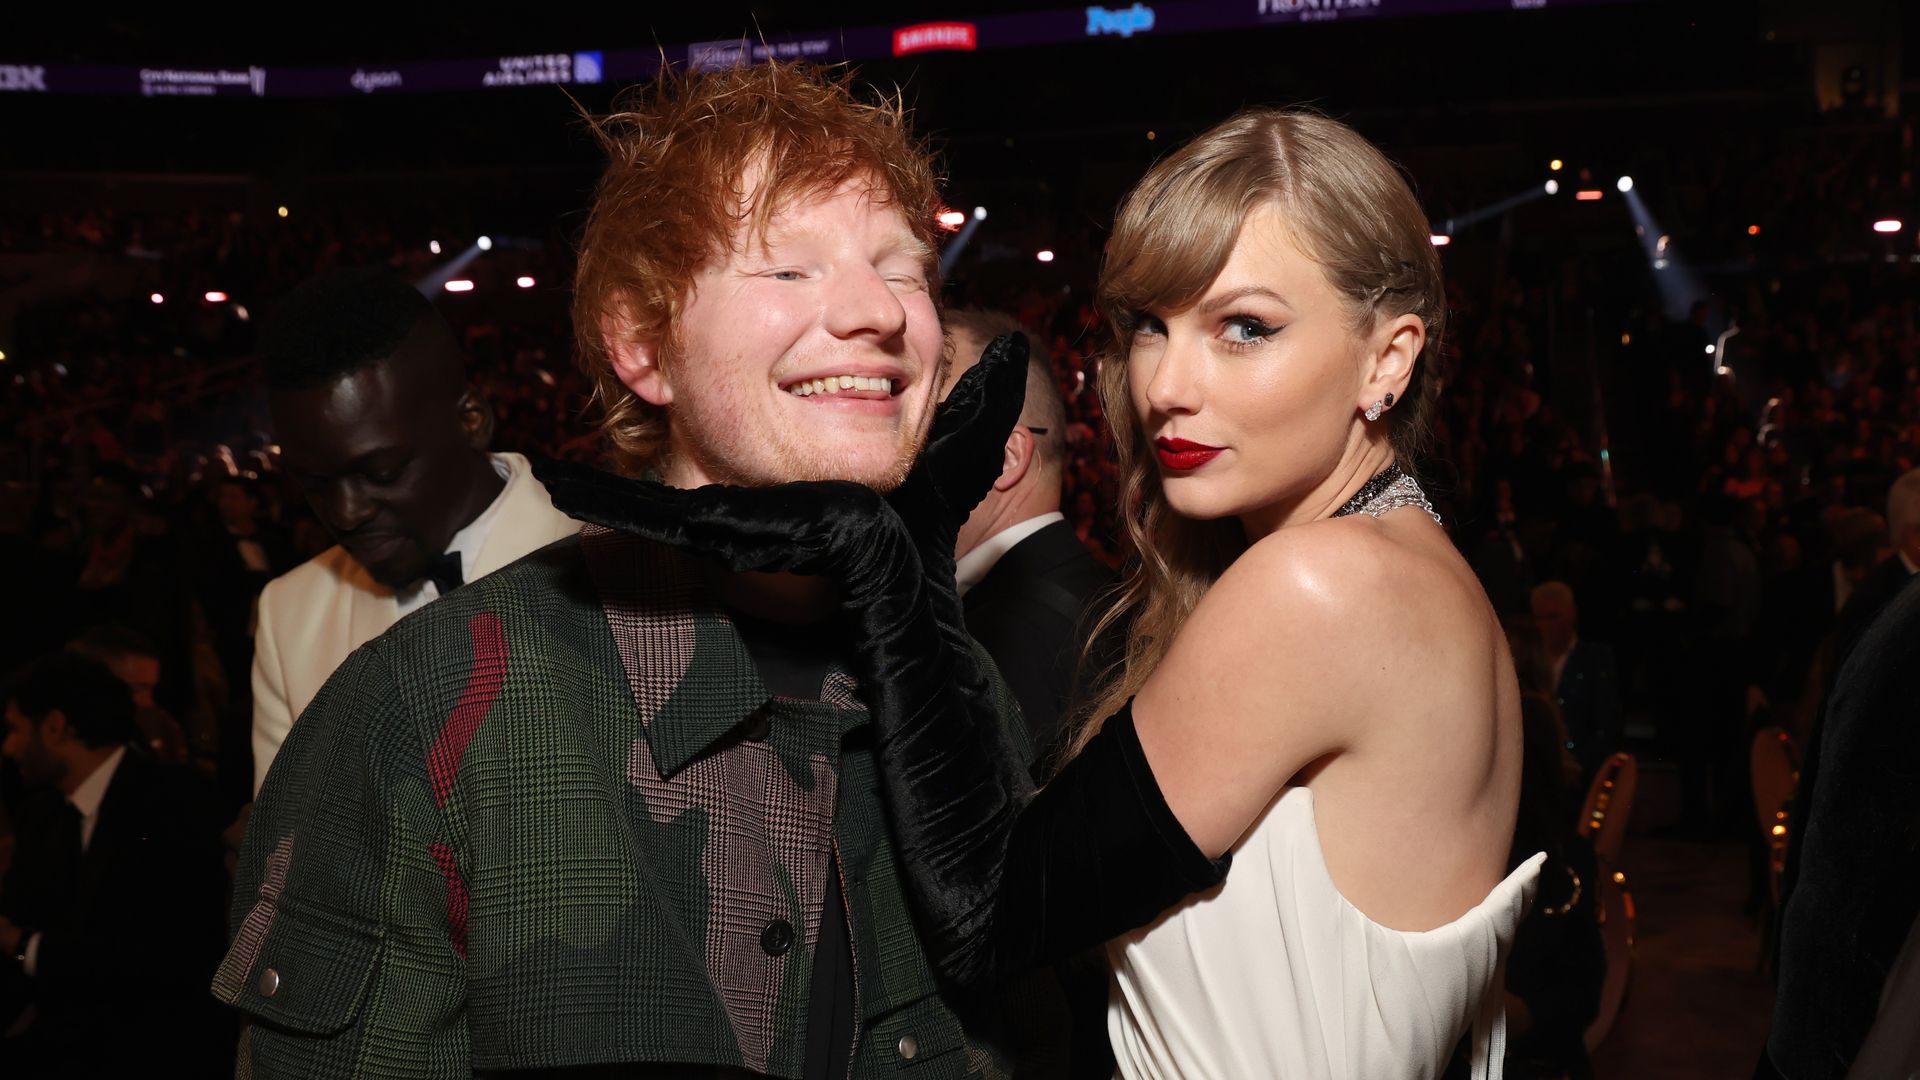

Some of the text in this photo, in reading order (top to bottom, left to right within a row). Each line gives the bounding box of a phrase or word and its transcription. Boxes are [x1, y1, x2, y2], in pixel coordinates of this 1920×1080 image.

[1085, 2, 1155, 38] People
[899, 26, 969, 50] SMIRNOFF
[499, 54, 571, 69] UNITED
[350, 68, 403, 93] dyson
[482, 69, 571, 86] AIRLINES
